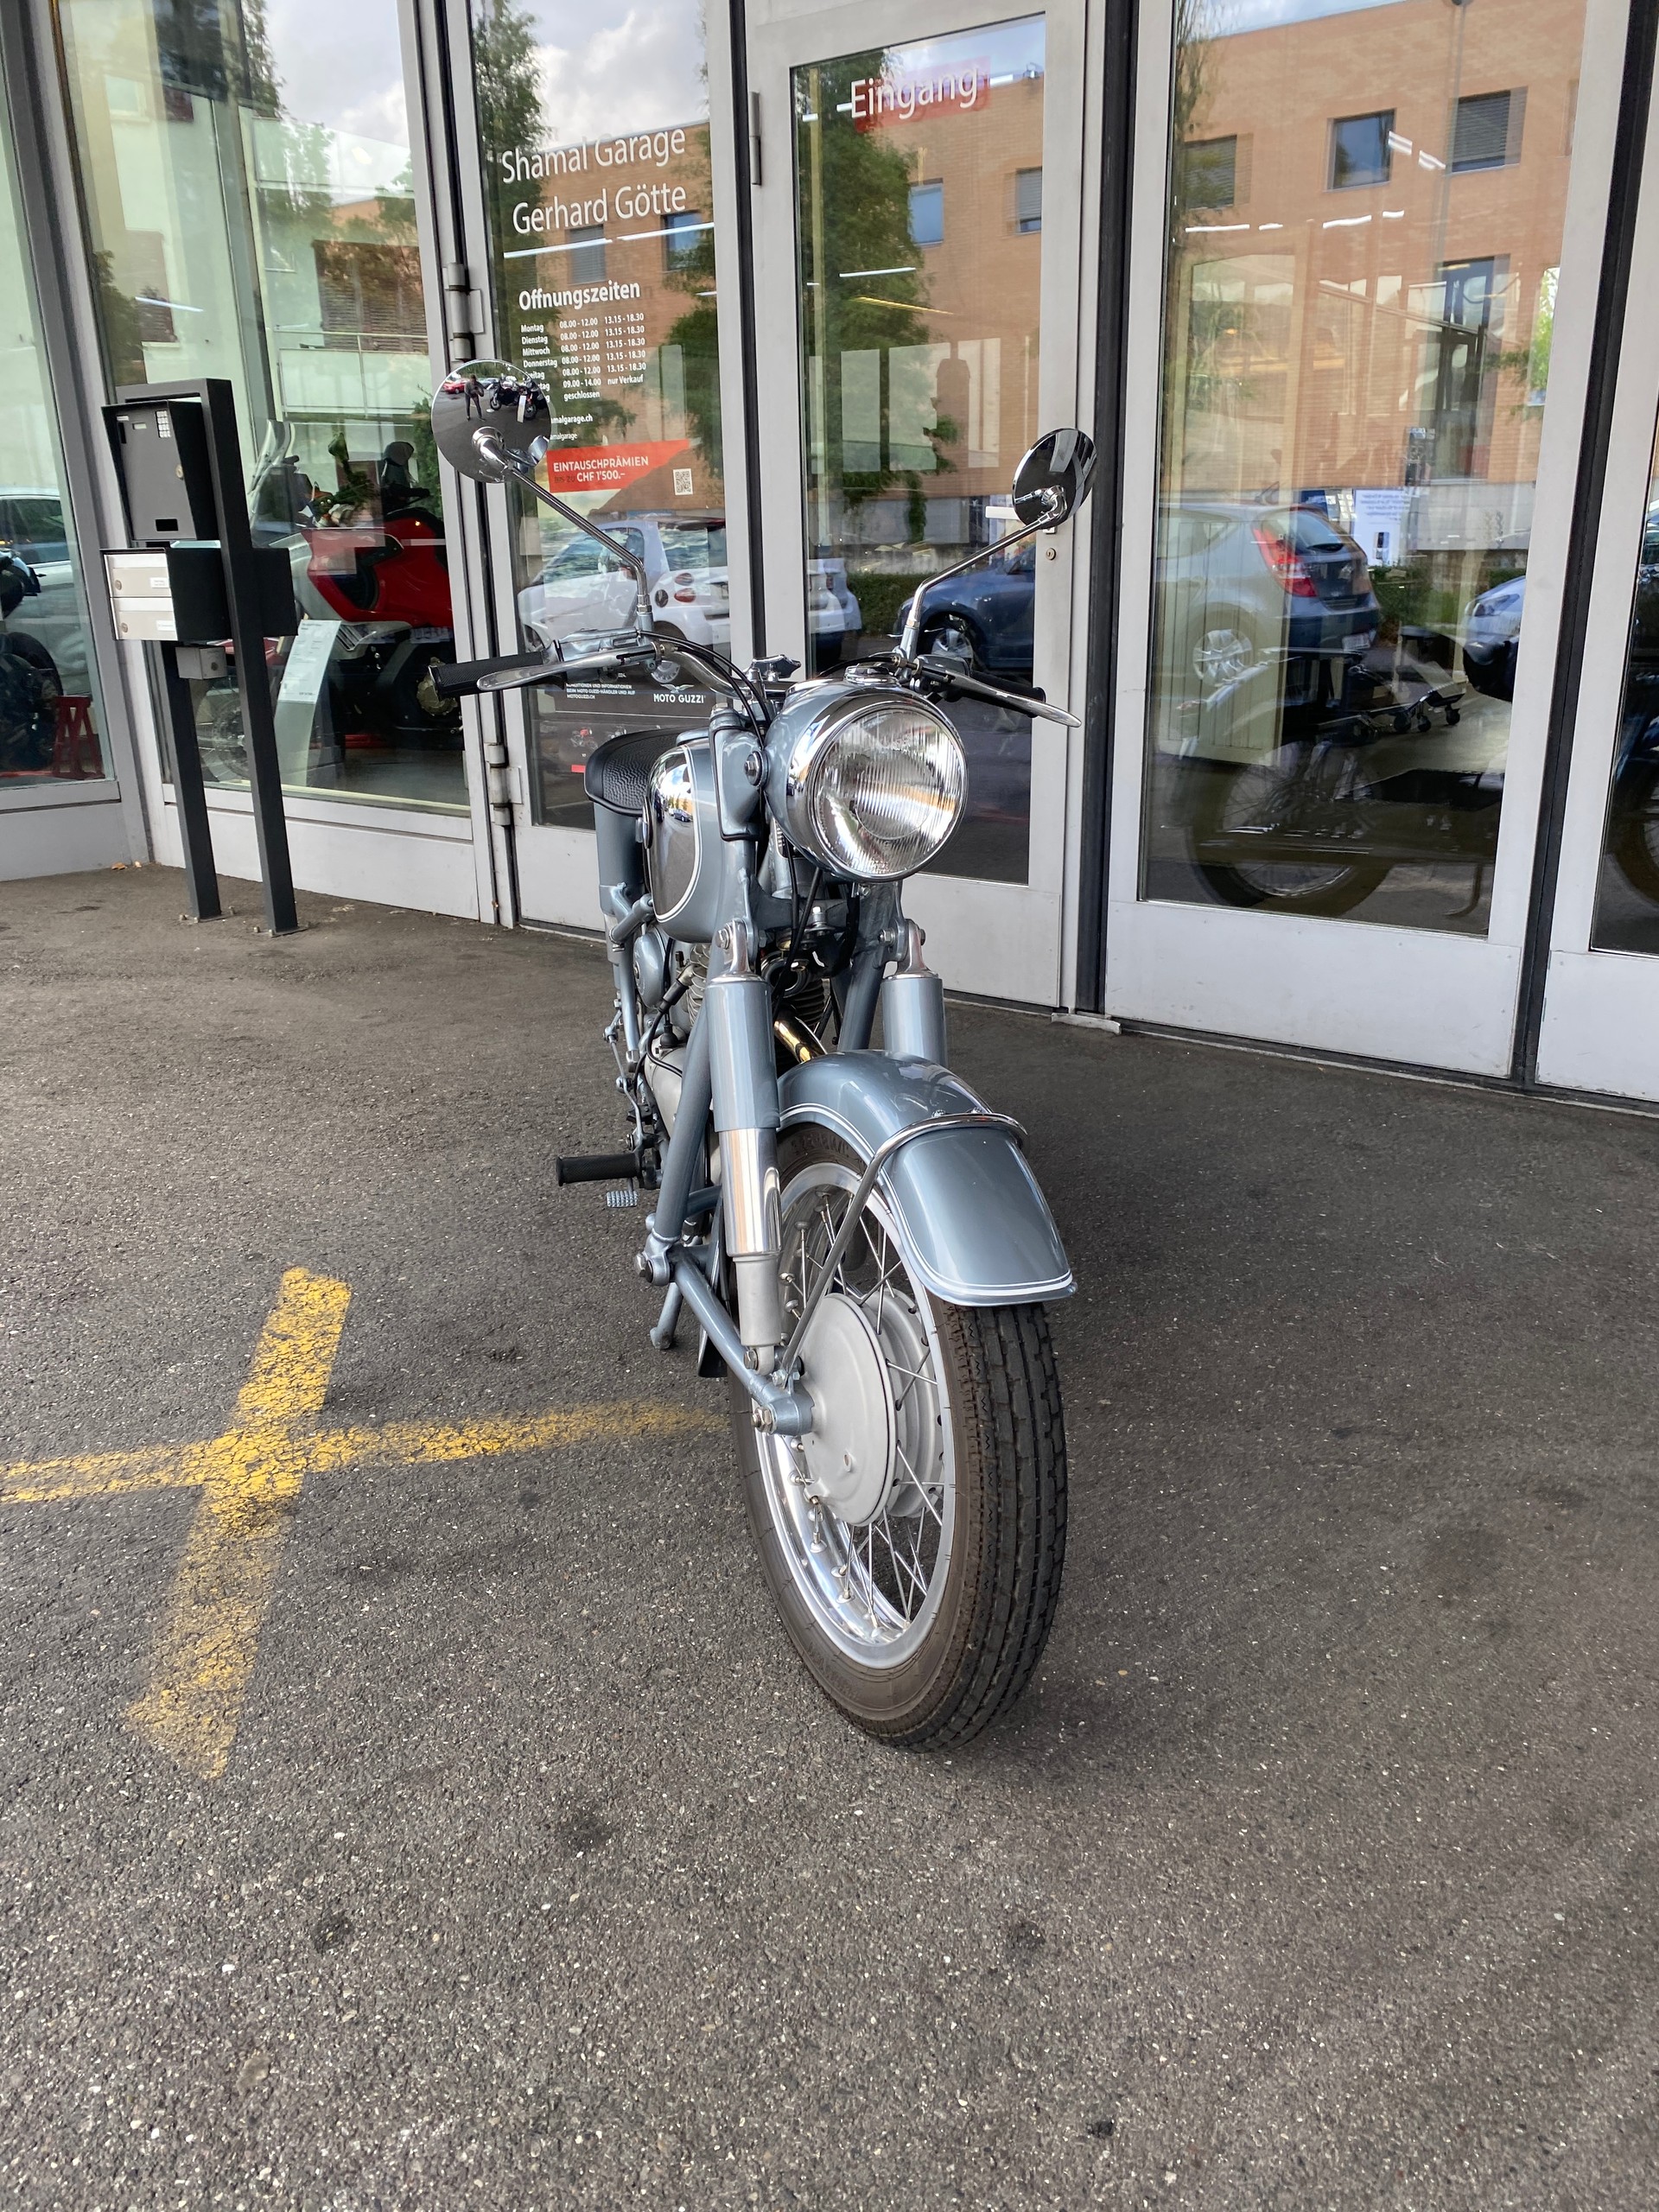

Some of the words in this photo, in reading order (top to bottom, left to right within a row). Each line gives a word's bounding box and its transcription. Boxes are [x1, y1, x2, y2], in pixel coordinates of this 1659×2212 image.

[851, 67, 978, 119] Eingang
[501, 136, 588, 183] Shamal
[594, 128, 686, 167] Garage
[512, 188, 608, 234] Gerhard
[614, 184, 687, 220] Götte
[521, 324, 544, 334] Montag
[559, 319, 576, 329] 08.00
[582, 317, 598, 327] 12.00
[605, 315, 621, 324] 13.15
[626, 313, 645, 322] 18.30
[522, 335, 548, 345] Dienstag
[560, 332, 577, 341] 08.00
[582, 329, 599, 340] 12.00
[605, 327, 622, 337] 13.15
[627, 325, 645, 334] 18.30
[522, 346, 550, 357] Mittwoch
[561, 344, 578, 353] 08.00
[582, 341, 600, 352] 12.00
[606, 340, 623, 349] 13.15
[627, 337, 645, 347] 18.30
[523, 358, 557, 368] Donnerstag
[562, 356, 579, 365] 08.00
[583, 353, 600, 363] 12.00
[607, 352, 623, 361] 13.15
[628, 350, 646, 359] 18.30
[525, 371, 545, 380] eitag
[563, 368, 580, 377] 08.00
[584, 365, 601, 376] 12.00
[607, 364, 624, 373] 13.15
[629, 362, 646, 372] 18.30
[563, 379, 580, 388] 09.00
[584, 378, 601, 388] 14.00
[619, 373, 645, 384] Verkauf
[563, 391, 601, 402] geschlossen
[553, 455, 649, 473] EINTAUSCHPRÄMIEN
[576, 471, 594, 482] CHF
[653, 693, 676, 703] MOTO
[678, 694, 704, 703] GUZZI
